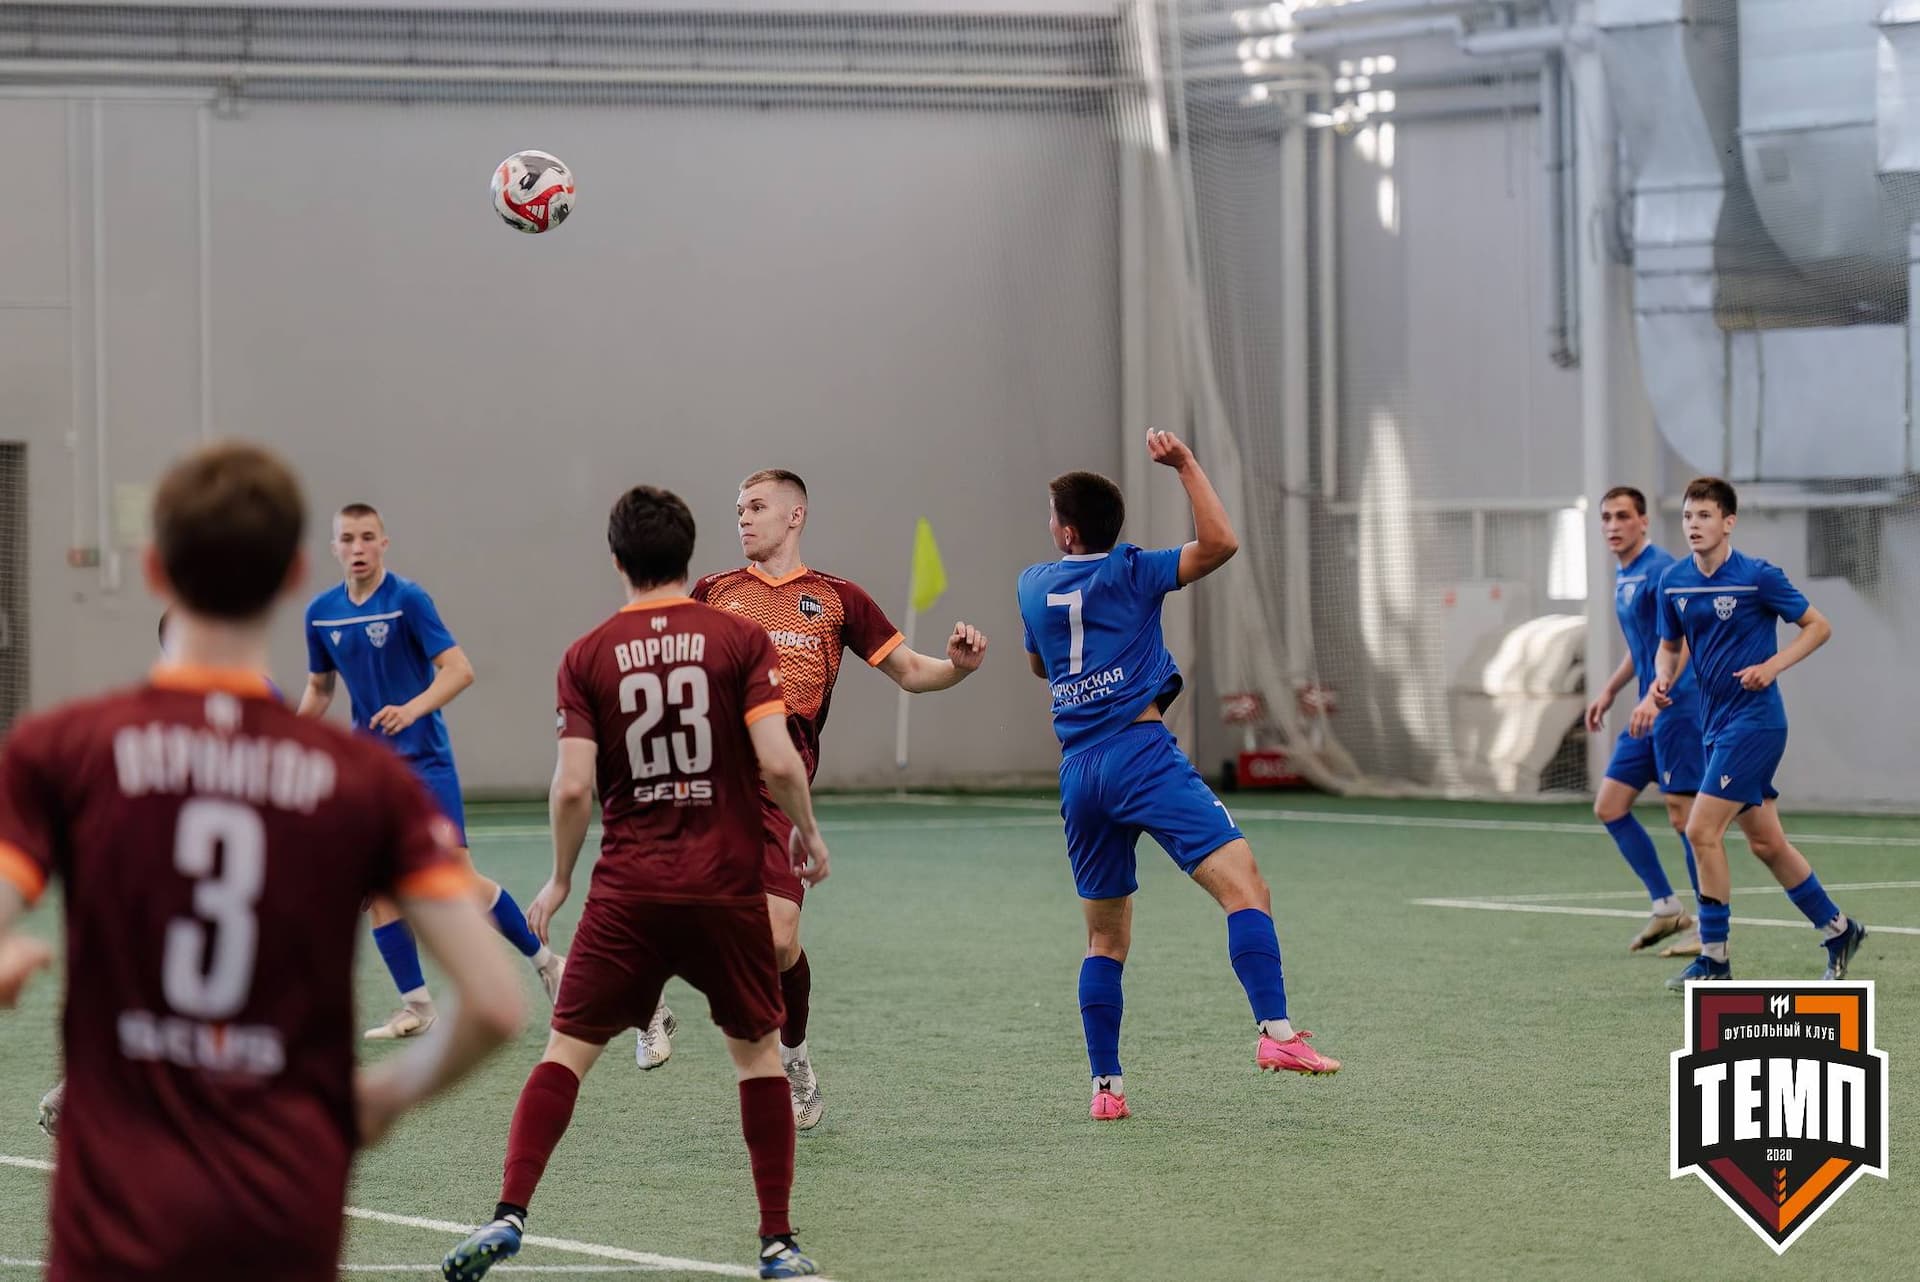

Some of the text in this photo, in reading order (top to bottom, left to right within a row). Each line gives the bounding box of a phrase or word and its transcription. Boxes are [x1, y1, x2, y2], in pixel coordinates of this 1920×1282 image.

[614, 633, 706, 673] ВОРОНА
[1047, 589, 1084, 675] 7
[1050, 666, 1125, 698] ИРКУТСКАЯ
[618, 665, 713, 780] 23
[633, 780, 713, 803] SEUS
[162, 798, 266, 1018] 3
